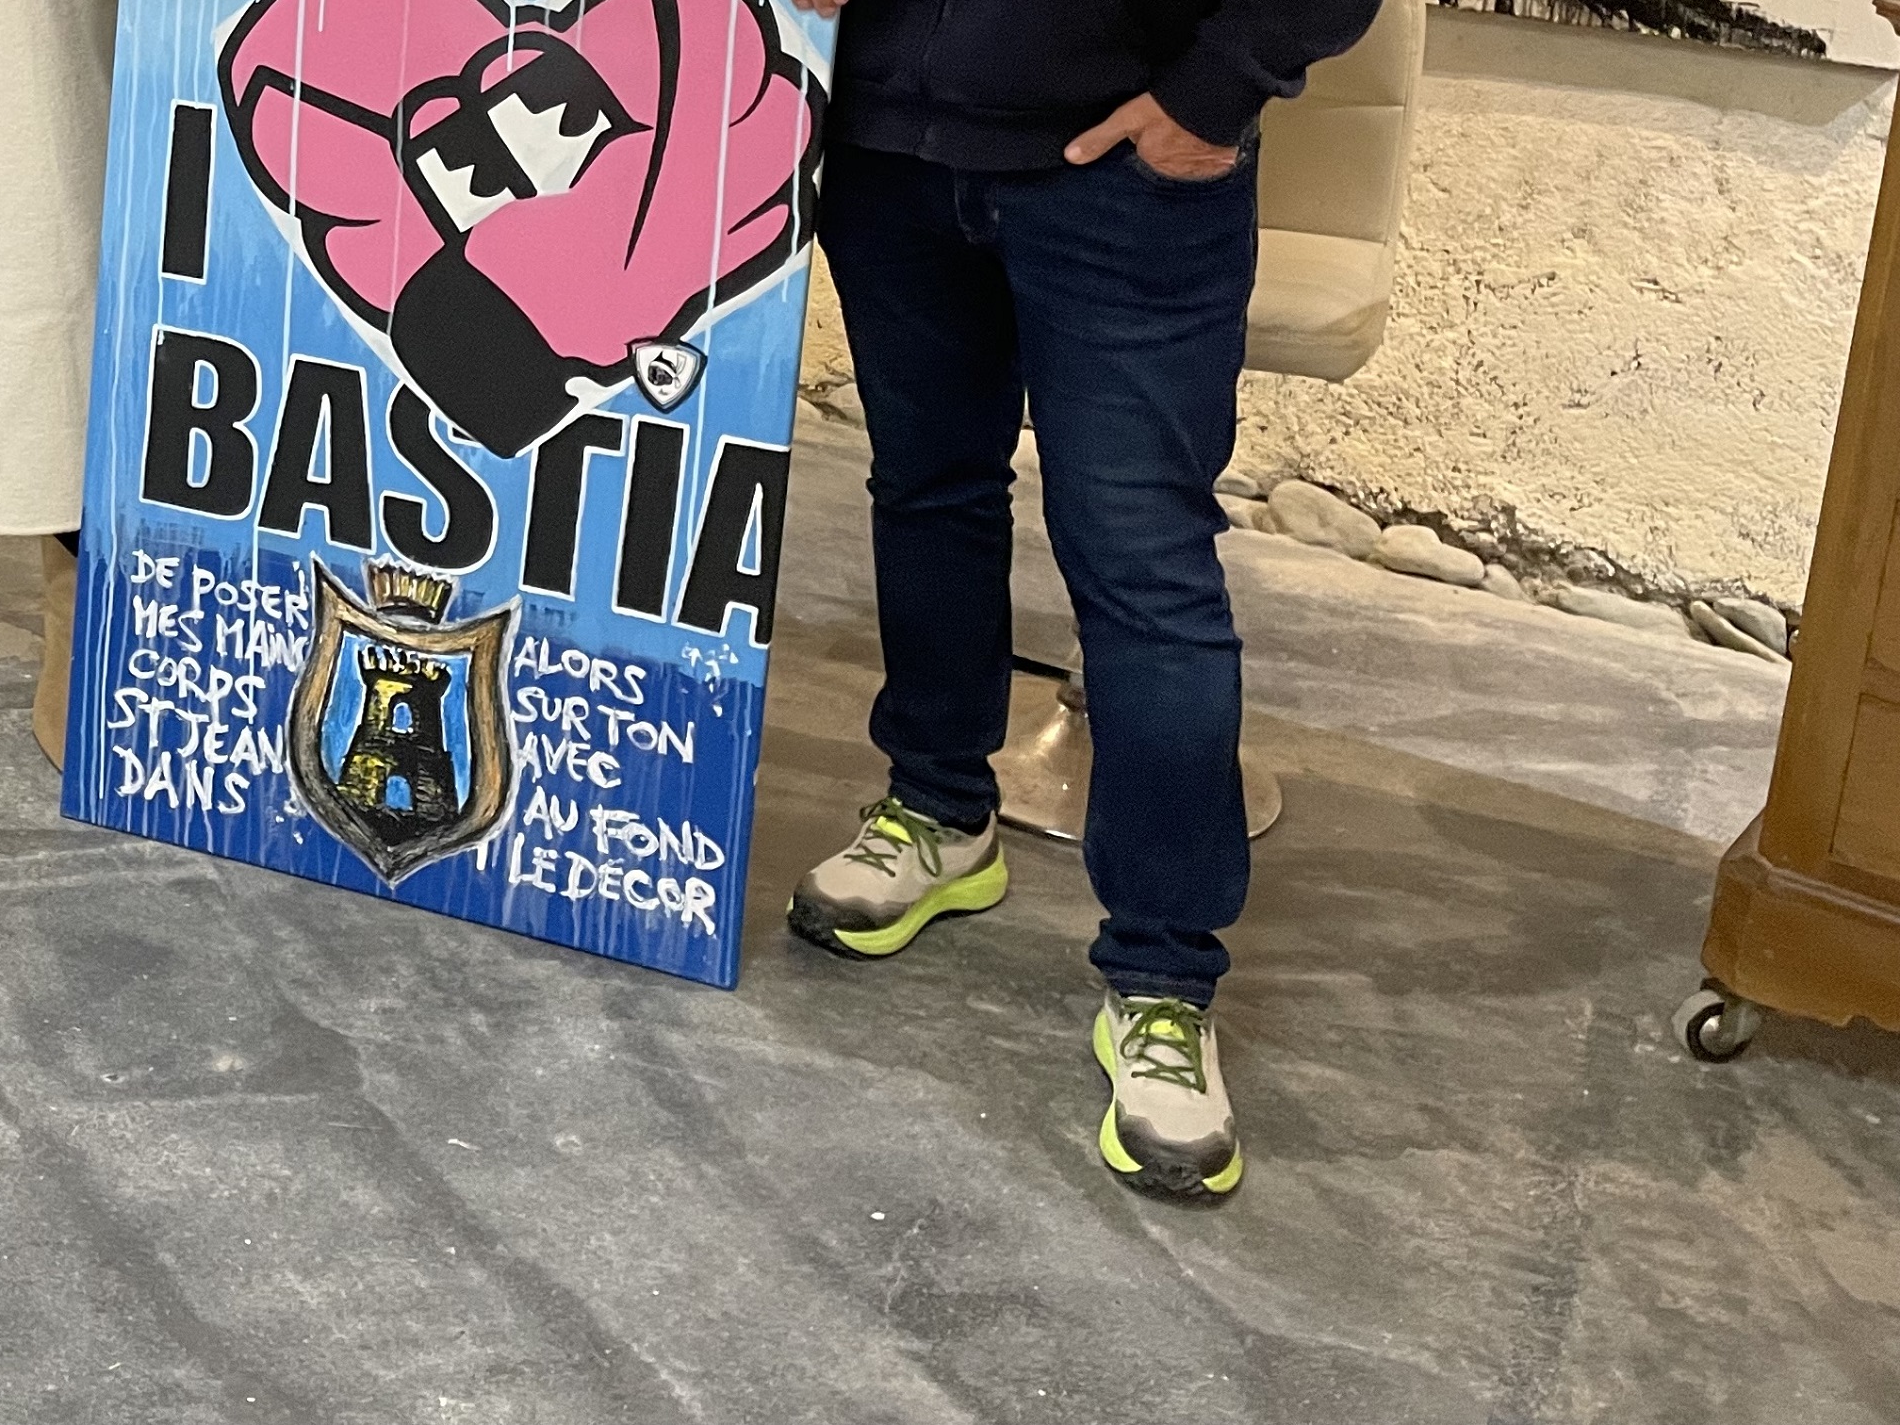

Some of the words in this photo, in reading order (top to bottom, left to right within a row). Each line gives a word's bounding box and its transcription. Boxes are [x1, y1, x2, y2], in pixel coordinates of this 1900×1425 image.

[161, 100, 217, 282] I
[139, 324, 790, 648] BASTIA
[131, 549, 180, 589] DE
[192, 564, 309, 630] POSER
[514, 636, 647, 705] ALORS
[132, 594, 204, 653] MES
[510, 686, 591, 741] SUR
[597, 704, 695, 764] TON
[112, 745, 250, 814] DANS
[128, 649, 266, 724] CORPS
[518, 731, 622, 788] AVEC
[523, 785, 579, 840] AU
[590, 803, 725, 870] FOND
